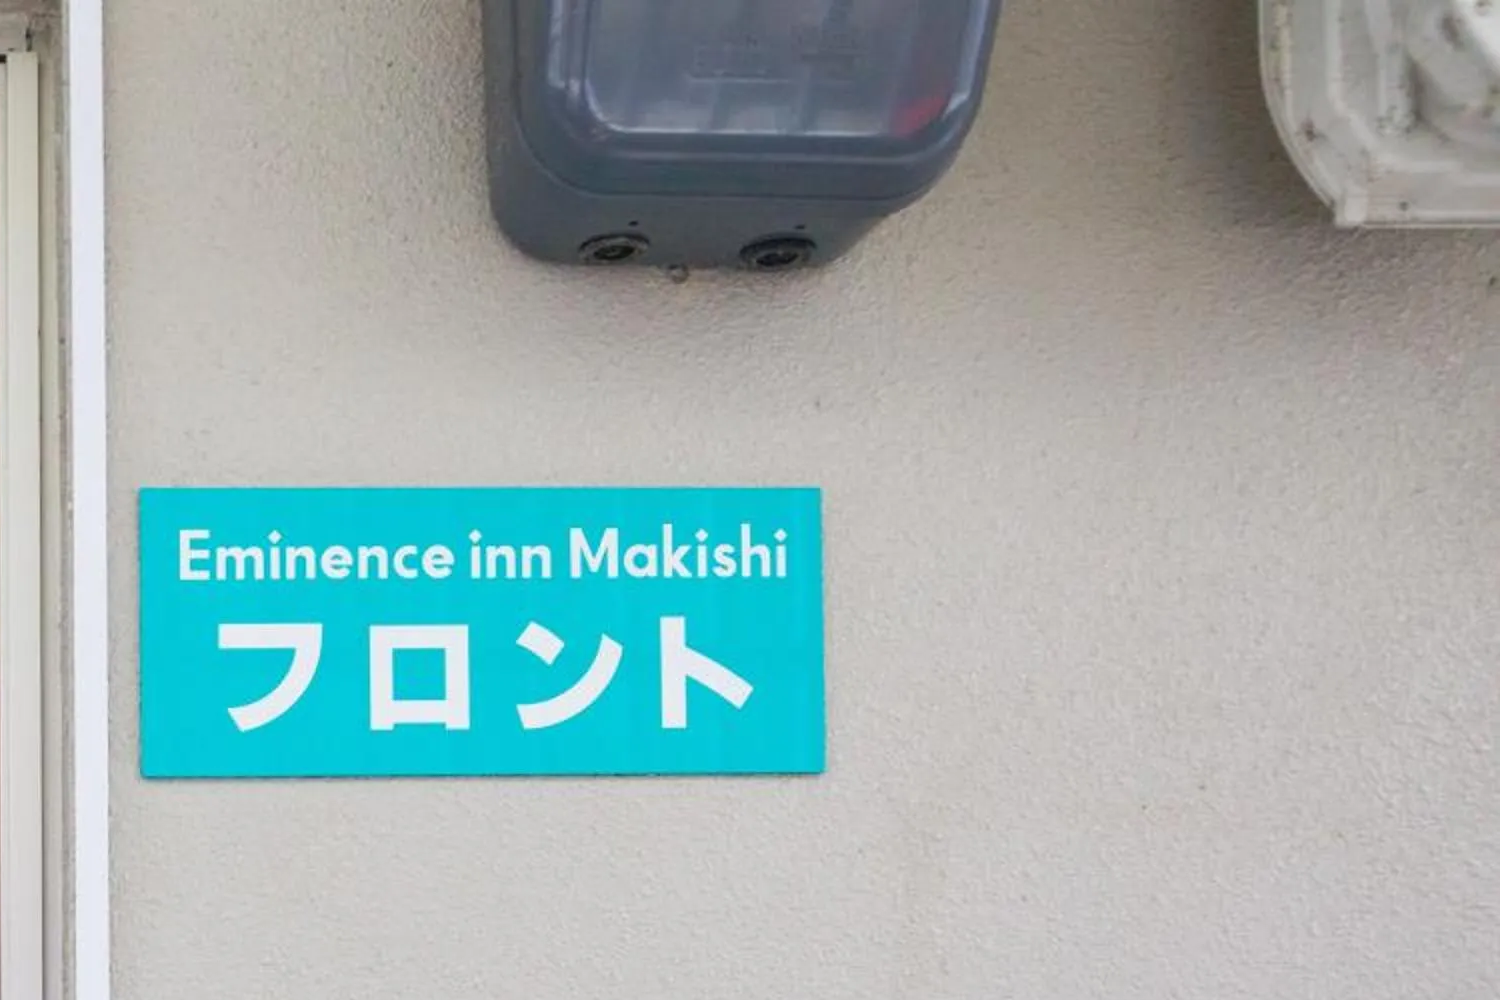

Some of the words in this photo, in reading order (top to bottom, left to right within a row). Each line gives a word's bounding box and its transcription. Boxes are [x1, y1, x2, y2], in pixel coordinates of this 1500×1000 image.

[179, 528, 455, 581] Eminence
[468, 529, 552, 579] inn
[569, 523, 788, 578] Makishi
[217, 615, 755, 733] フロント
